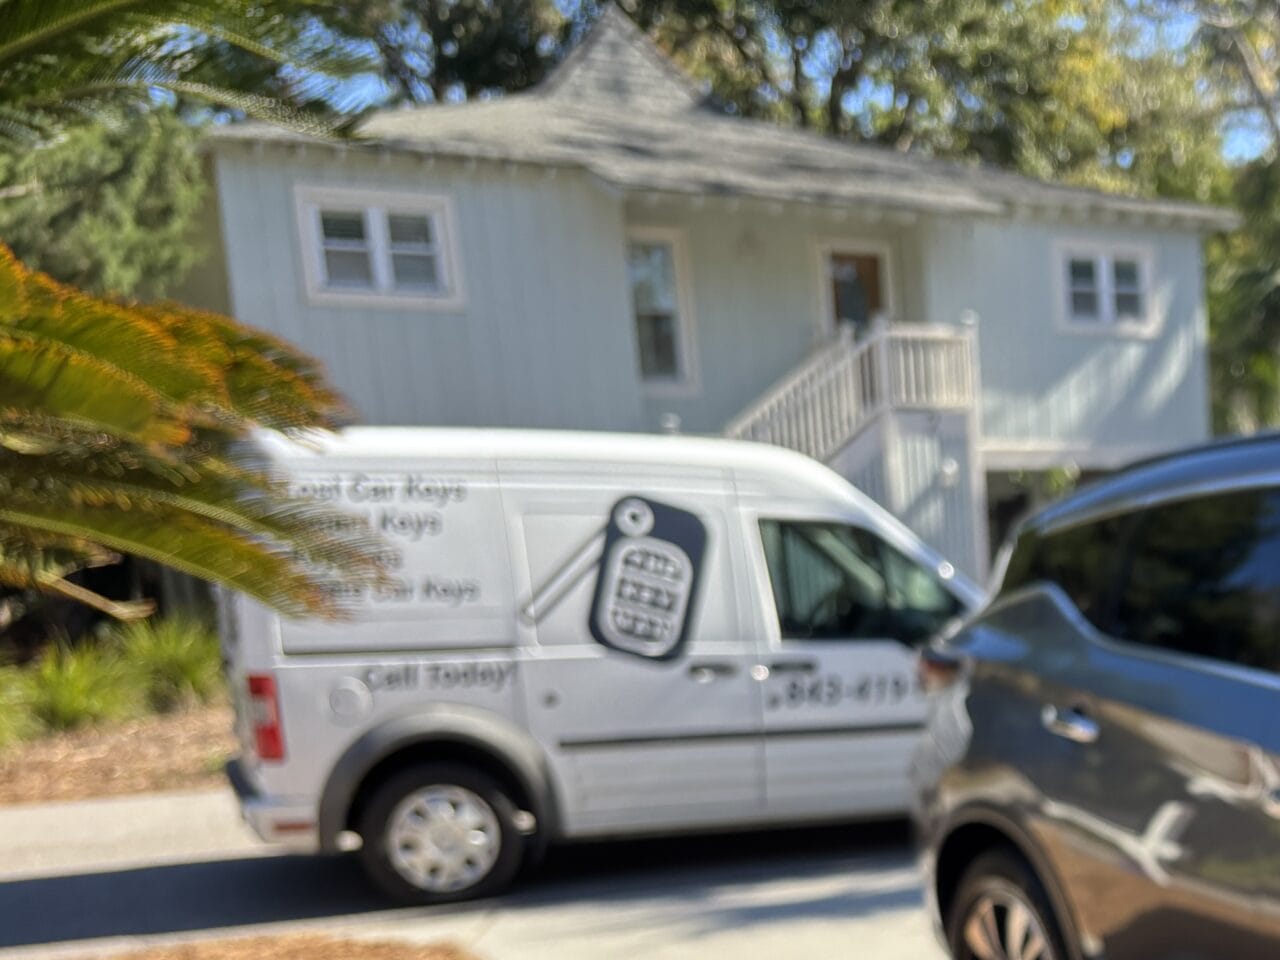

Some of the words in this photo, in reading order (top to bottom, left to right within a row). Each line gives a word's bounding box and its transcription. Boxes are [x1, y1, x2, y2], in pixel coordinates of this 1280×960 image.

[404, 473, 466, 507] Keys
[379, 509, 442, 541] Keys
[422, 575, 481, 608] Keys
[363, 665, 419, 692] Call
